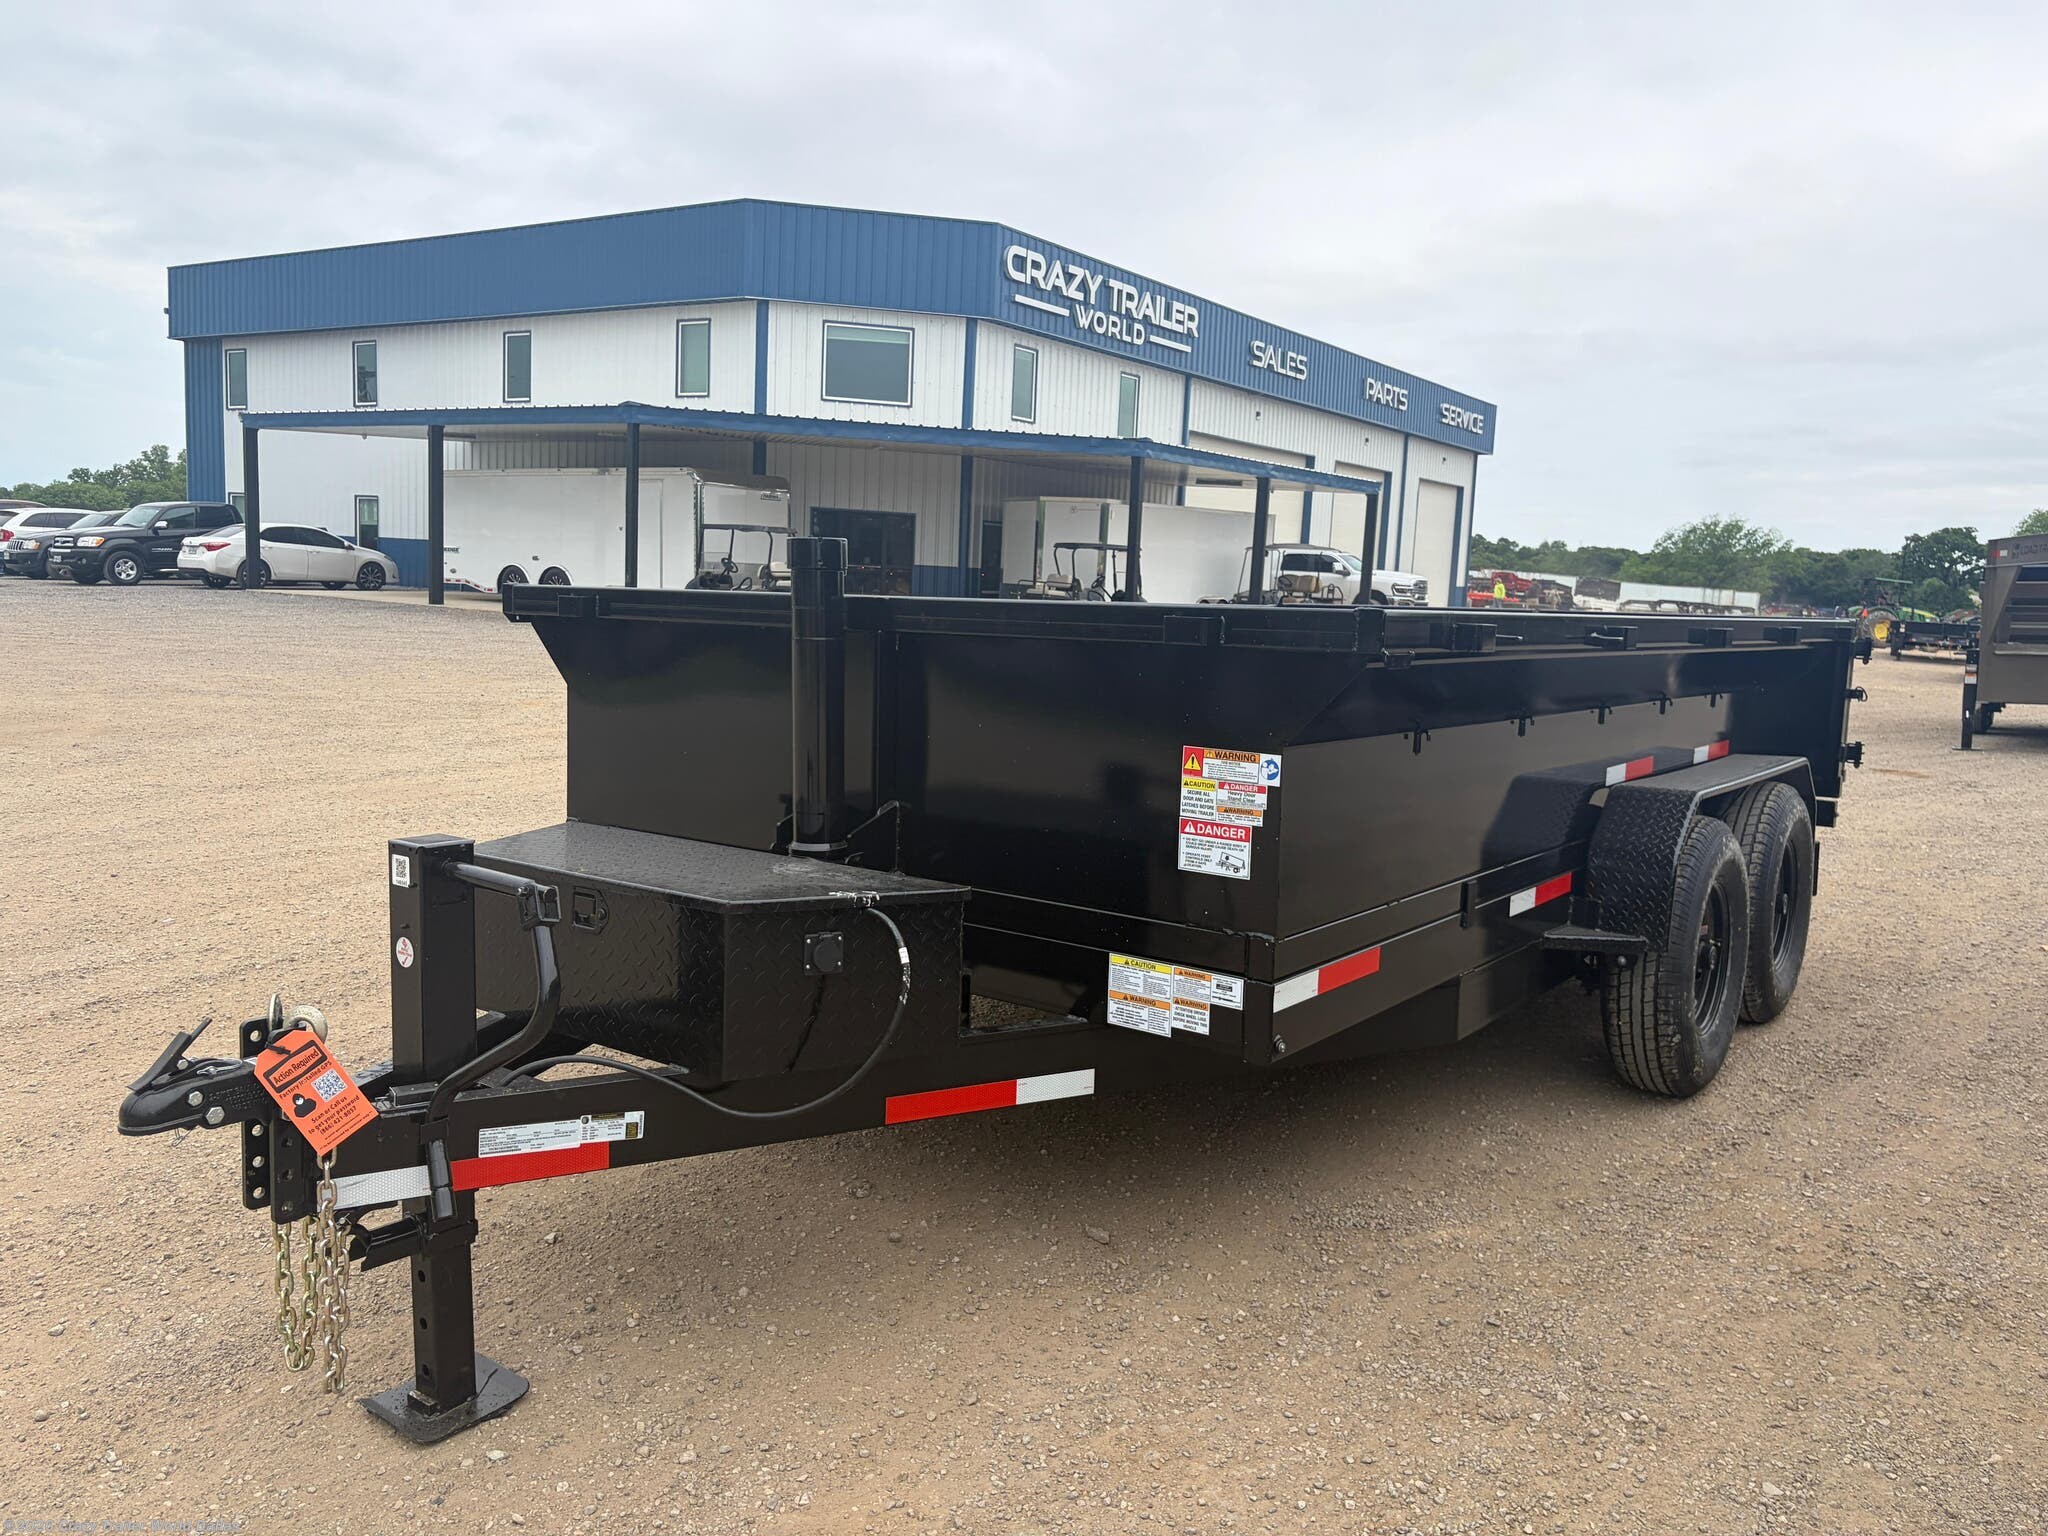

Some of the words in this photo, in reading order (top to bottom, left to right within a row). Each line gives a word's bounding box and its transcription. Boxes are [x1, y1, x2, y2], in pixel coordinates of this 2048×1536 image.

[1005, 244, 1104, 305] CRAZY
[1106, 278, 1199, 337] TRAILER
[1074, 303, 1145, 345] WORLD
[1251, 340, 1308, 381] SALES
[1364, 377, 1409, 411] PARTS
[1440, 402, 1484, 434] SERVICE
[1215, 750, 1257, 763] WARNING
[1189, 780, 1216, 789] CAUTION
[1230, 783, 1258, 792] DANGER
[1227, 807, 1254, 816] WARNING
[1197, 823, 1246, 839] DANGER
[1130, 960, 1156, 970] CAUTION
[1184, 971, 1206, 980] WARNING
[1130, 994, 1157, 1007] WARNING
[1180, 999, 1207, 1010] WARNING
[273, 1067, 295, 1084] Action
[291, 1049, 320, 1072] Required
[279, 1084, 300, 1099] Factory
[299, 1068, 321, 1086] Installed
[320, 1060, 332, 1070] GPS
[311, 1112, 325, 1124] Scan
[330, 1100, 341, 1110] Call
[315, 1121, 325, 1131] get
[324, 1113, 336, 1125] your
[335, 1095, 360, 1116] password
